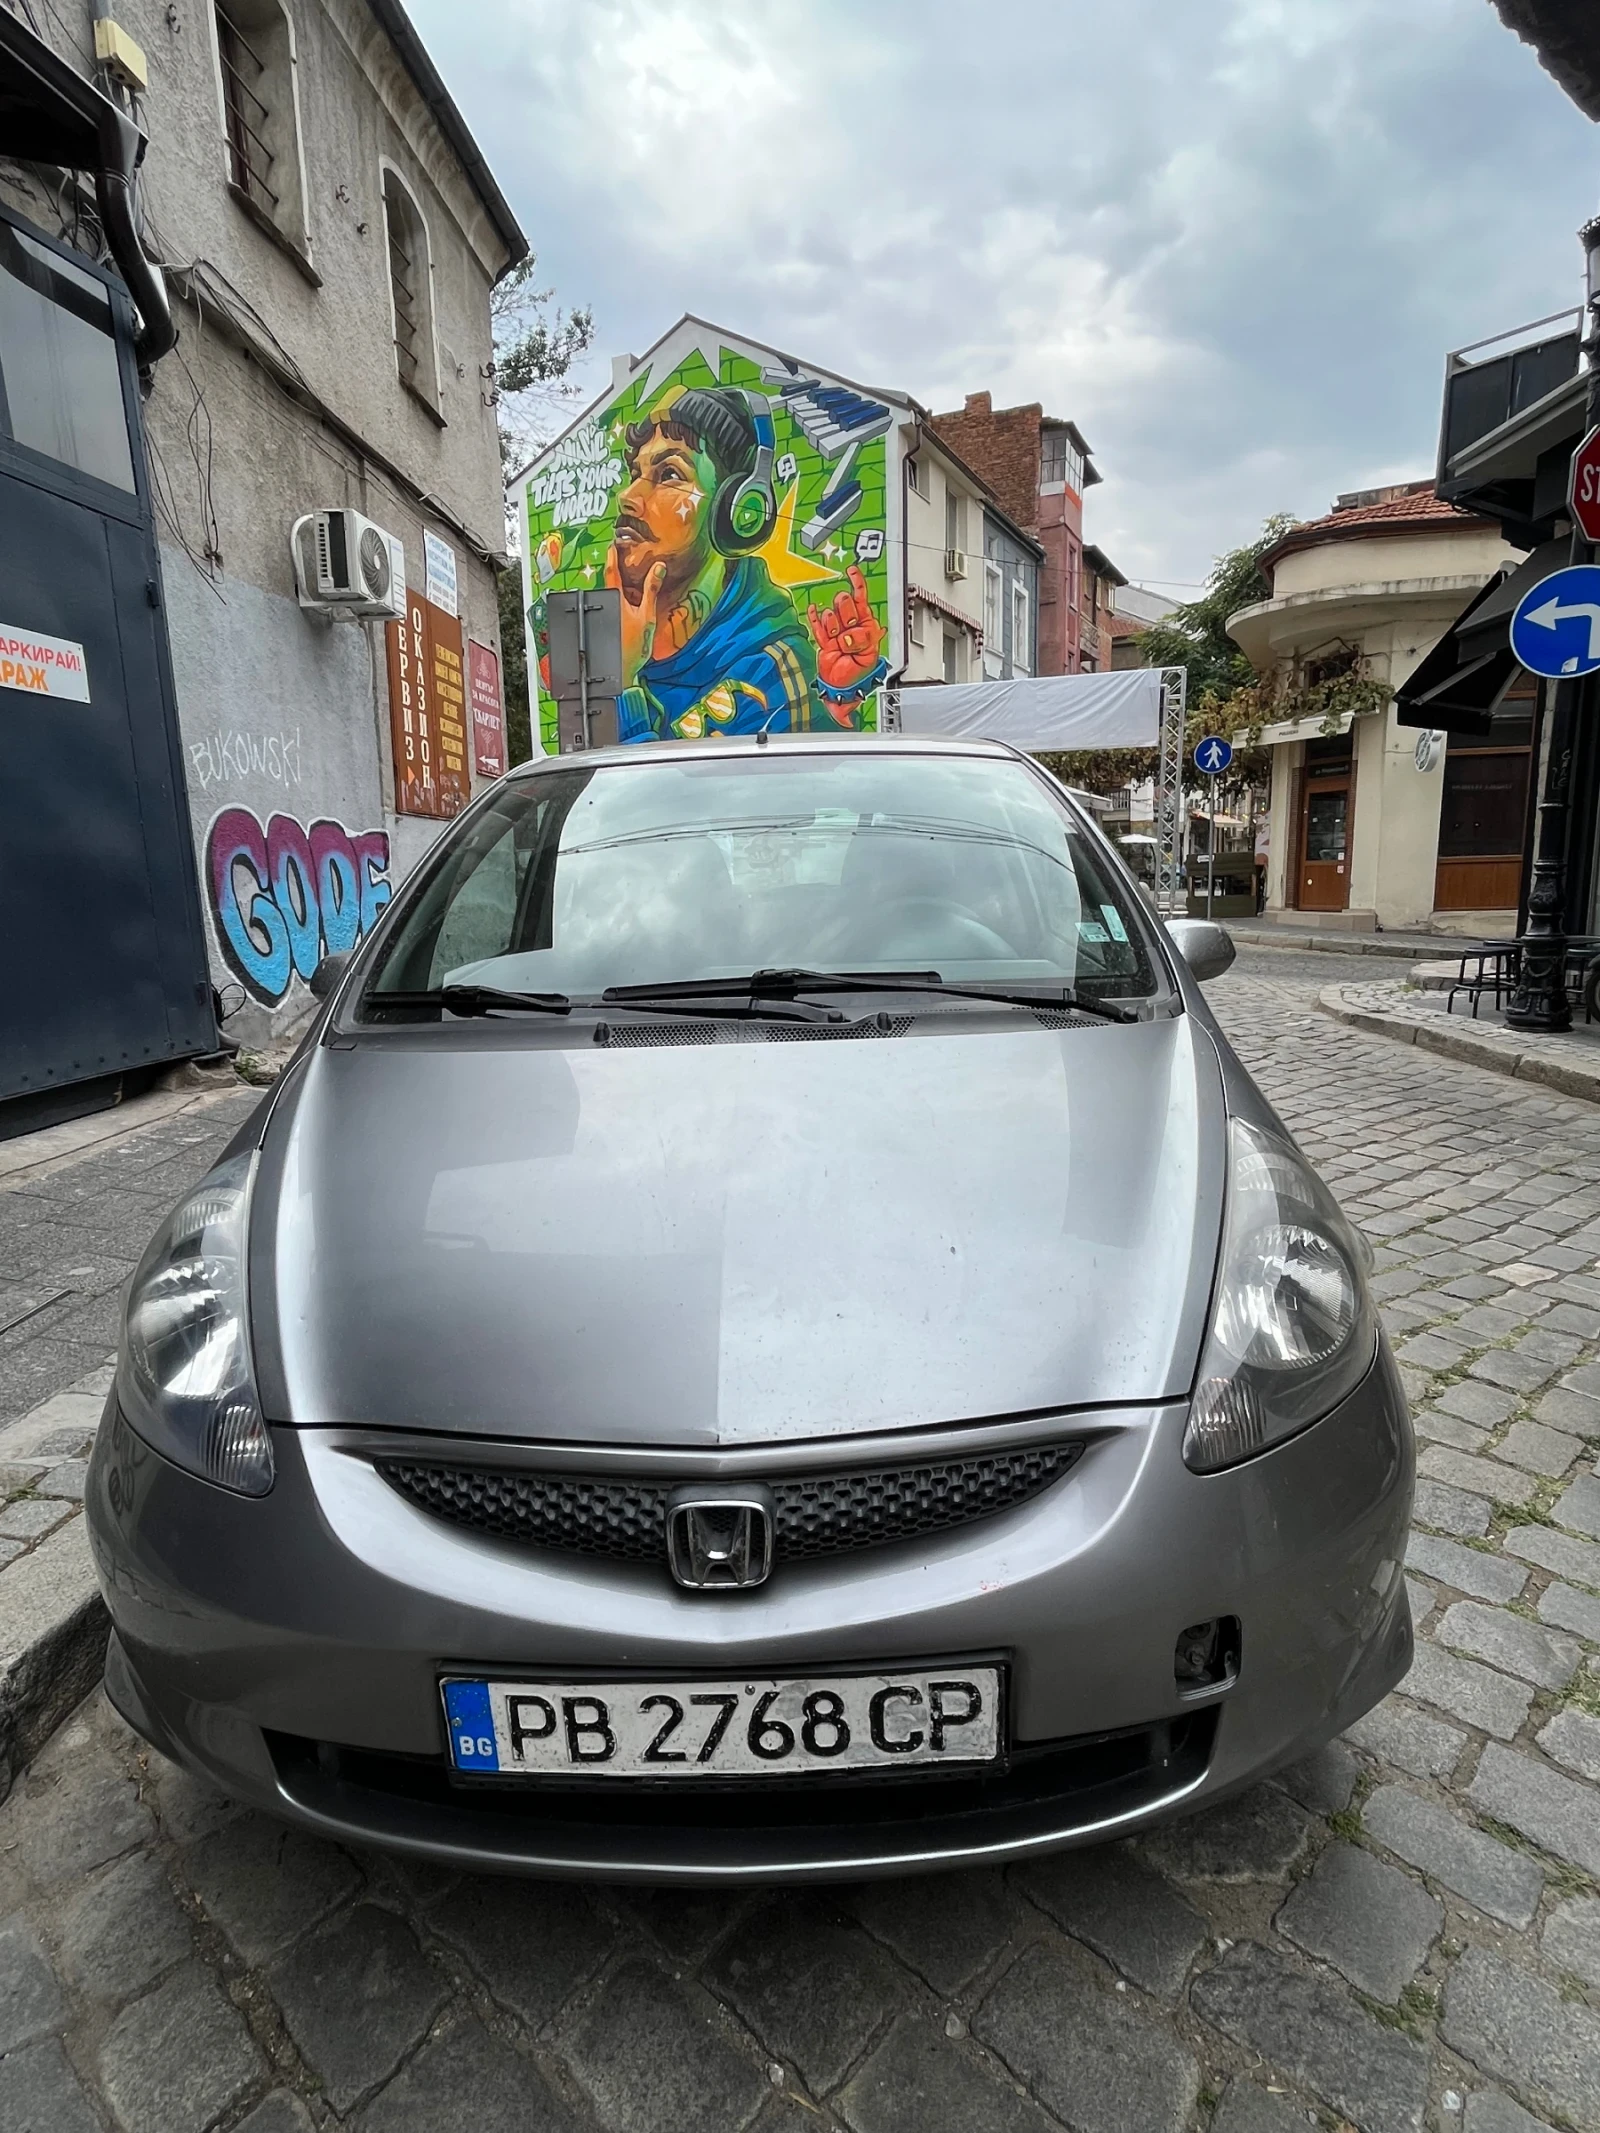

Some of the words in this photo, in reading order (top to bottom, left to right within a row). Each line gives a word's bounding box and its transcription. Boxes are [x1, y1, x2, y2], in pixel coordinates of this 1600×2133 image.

[549, 424, 608, 473] MUSIC
[531, 470, 576, 508] TILTS
[577, 458, 622, 492] YOUR
[553, 489, 608, 527] WORLD
[0, 659, 49, 691] РАЖ
[398, 617, 415, 761] ЕРВИЗ
[412, 607, 431, 789] ОКАЗИОН
[189, 727, 301, 791] BUKOWSKI
[458, 1735, 493, 1757] BG
[505, 1694, 617, 1763] PB
[637, 1690, 852, 1763] 2768
[869, 1681, 982, 1755] CP
